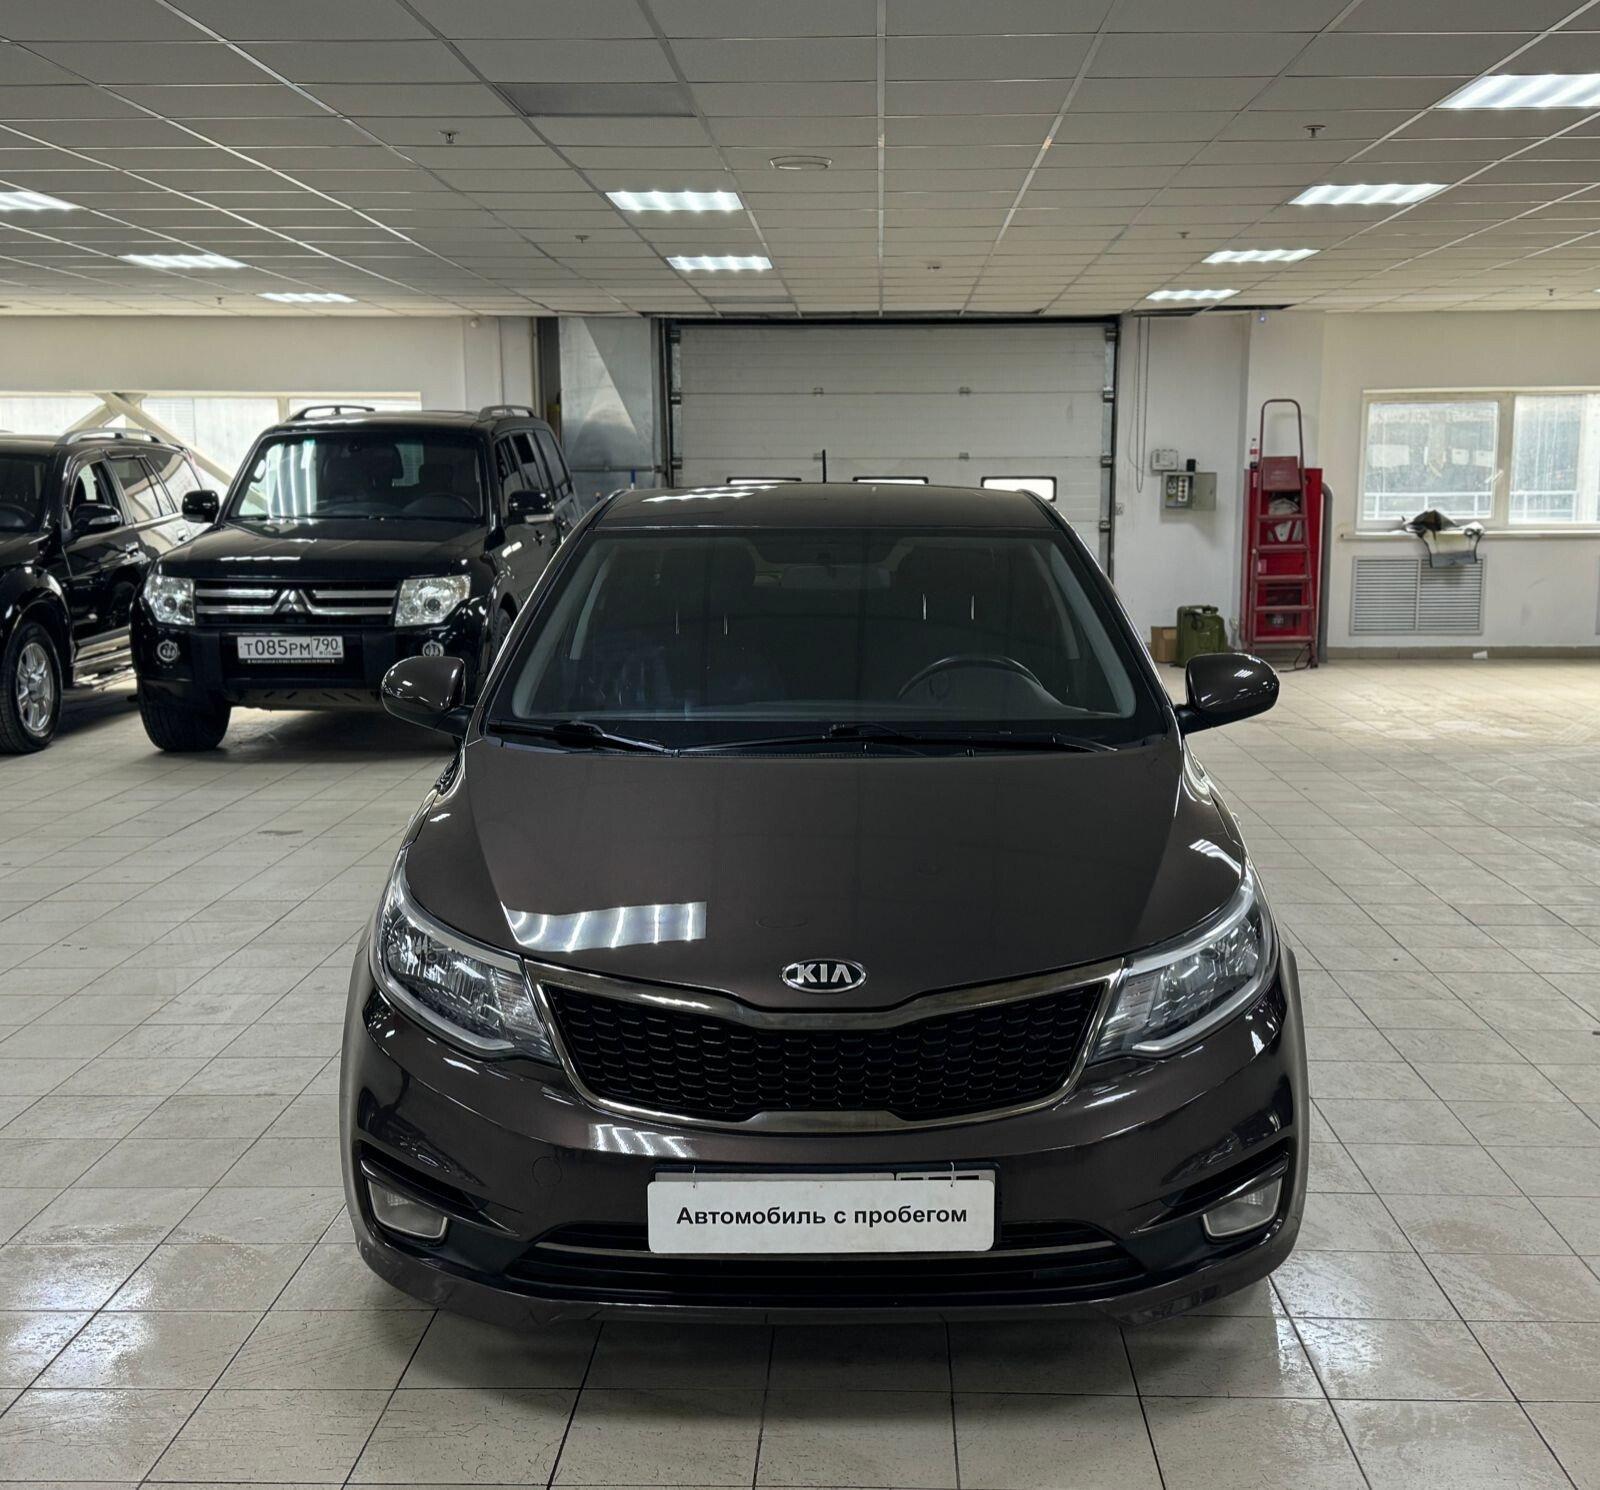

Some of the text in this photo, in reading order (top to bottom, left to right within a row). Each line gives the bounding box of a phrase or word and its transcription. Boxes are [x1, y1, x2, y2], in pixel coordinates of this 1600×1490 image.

[797, 963, 853, 984] KIA
[676, 1205, 967, 1228] Автомобиль с пробегом
